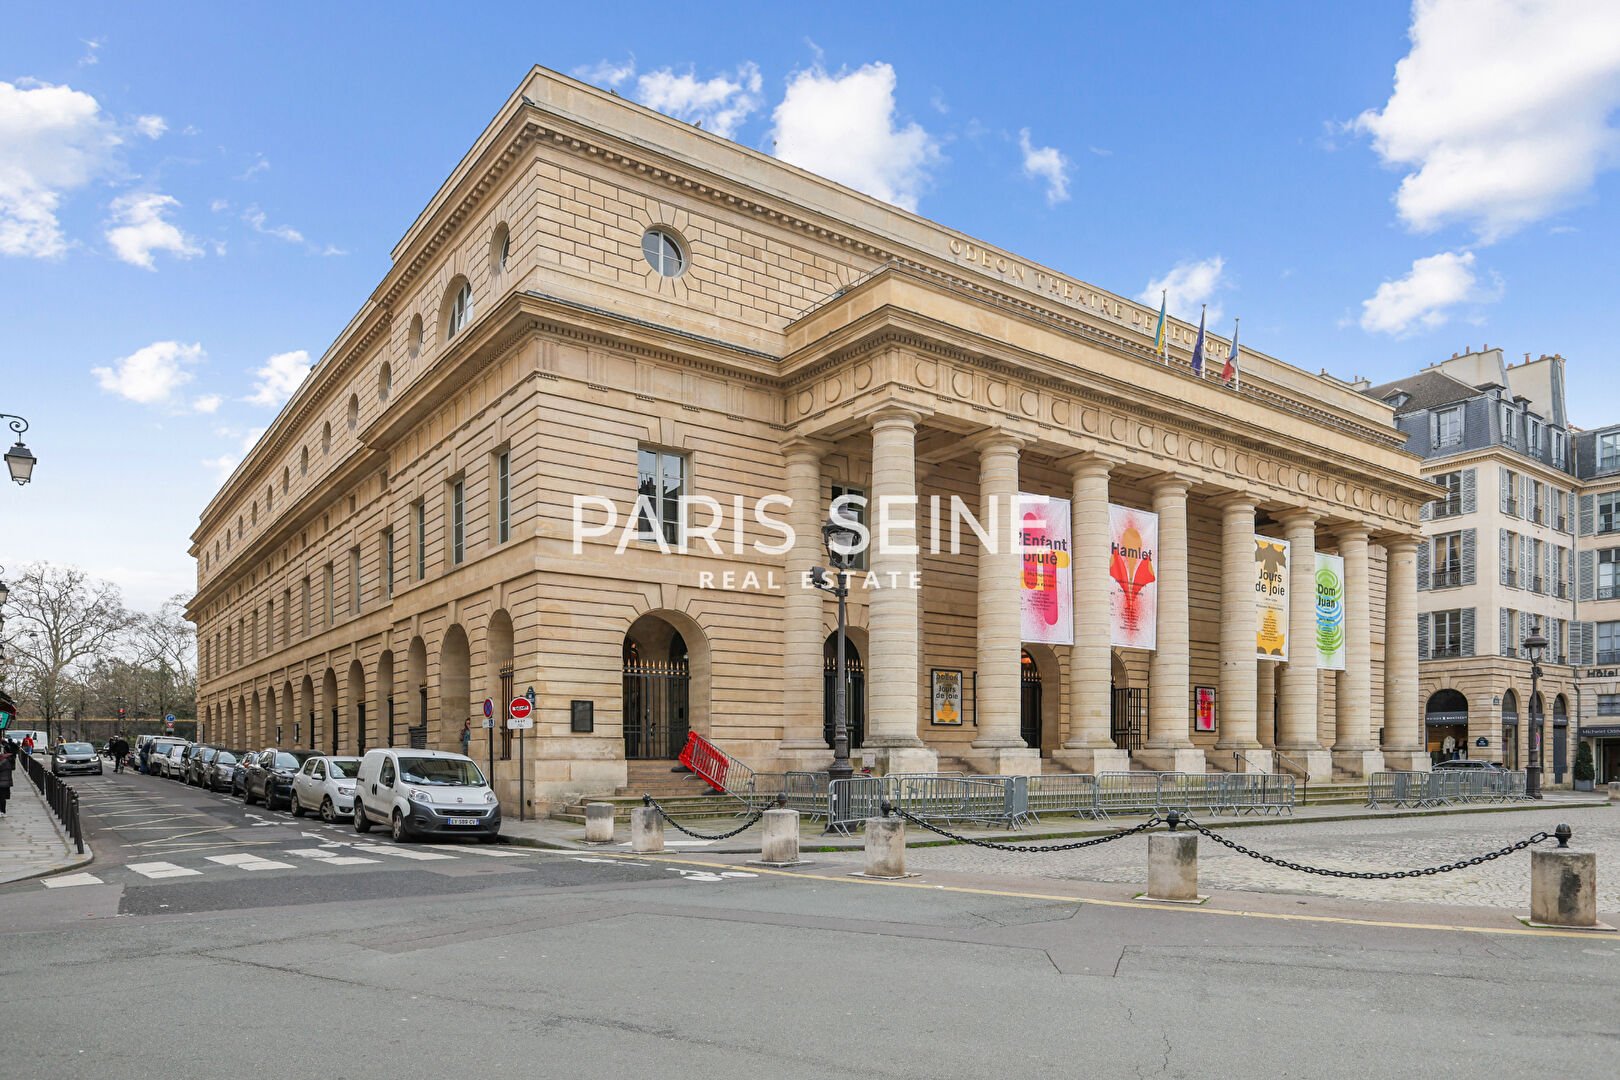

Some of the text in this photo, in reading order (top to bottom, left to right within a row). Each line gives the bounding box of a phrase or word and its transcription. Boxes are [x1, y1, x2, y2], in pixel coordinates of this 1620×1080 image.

[949, 240, 1024, 284] ODEON
[1034, 272, 1122, 319] THEATRE
[1131, 310, 1153, 331] DE
[1018, 531, 1067, 551] 'Enfant
[1111, 542, 1153, 562] Hamlet
[1258, 569, 1282, 583] Jours
[1255, 581, 1285, 596] de joie
[1317, 583, 1336, 596] Dom
[1317, 595, 1336, 609] Juan
